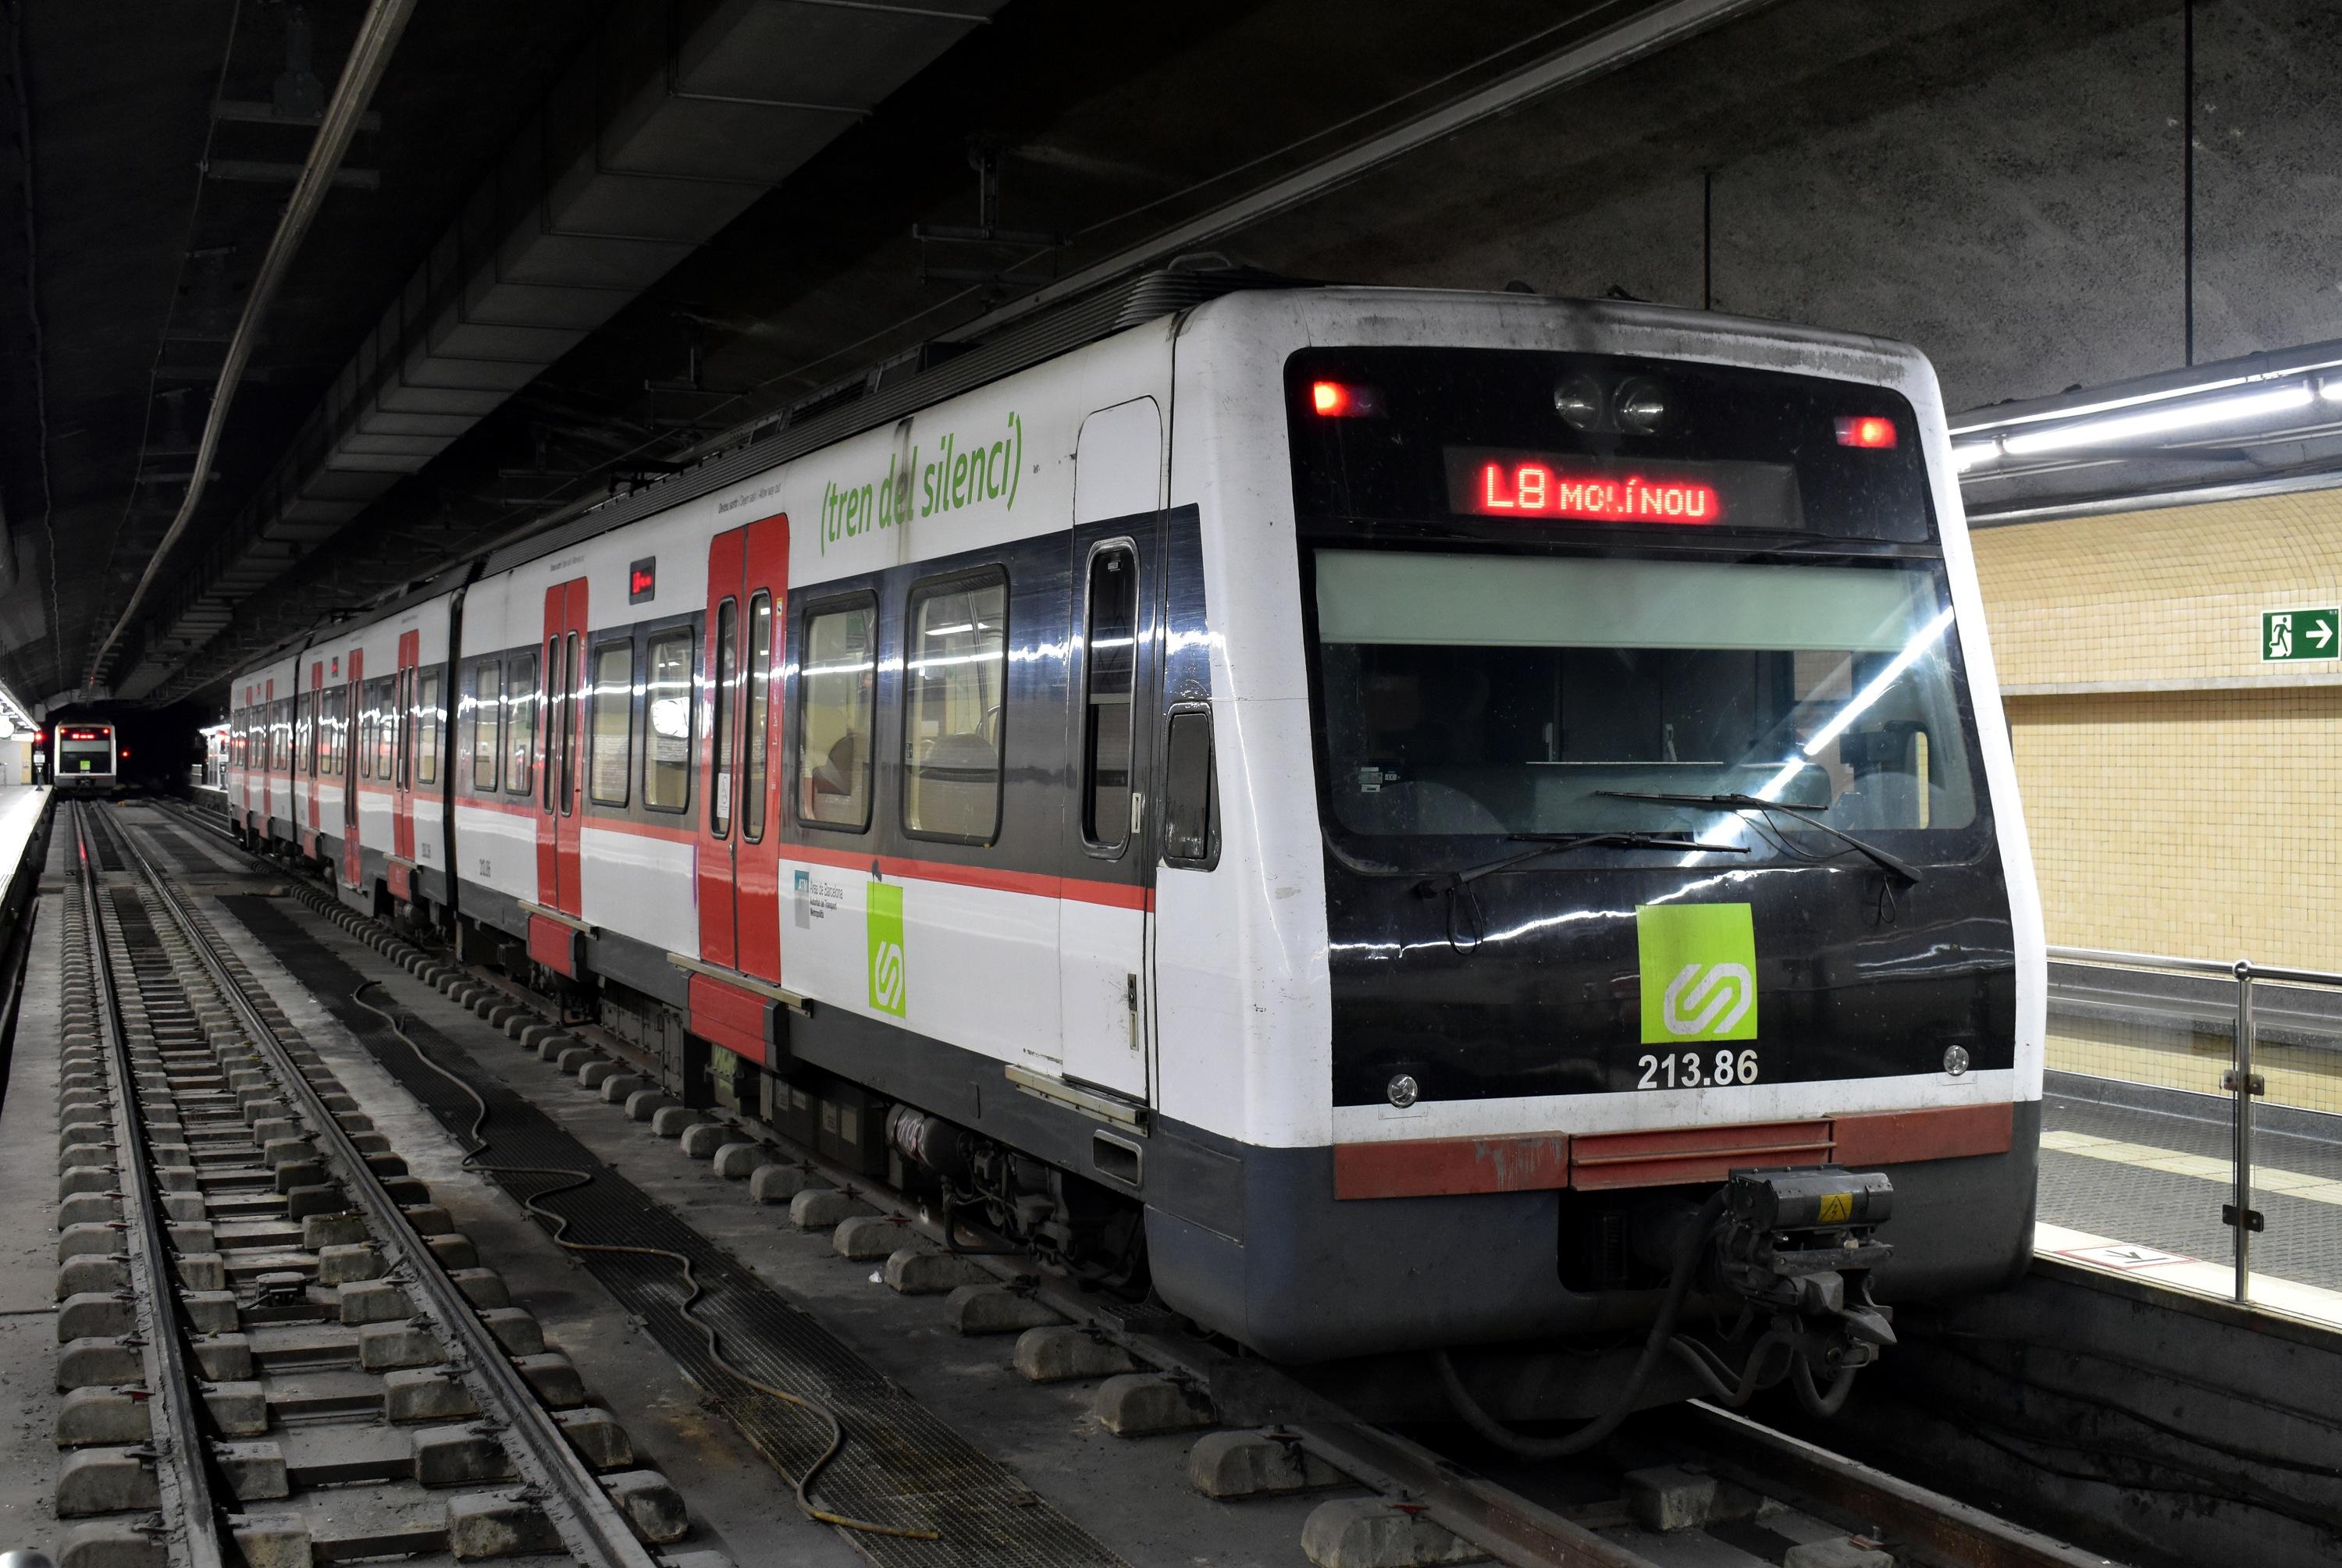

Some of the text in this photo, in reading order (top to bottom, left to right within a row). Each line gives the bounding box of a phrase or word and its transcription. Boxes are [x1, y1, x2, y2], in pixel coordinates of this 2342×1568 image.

[822, 411, 1022, 557] (tren del silenci)
[1487, 467, 1545, 509] L8
[1637, 1050, 1758, 1090] 213.86
